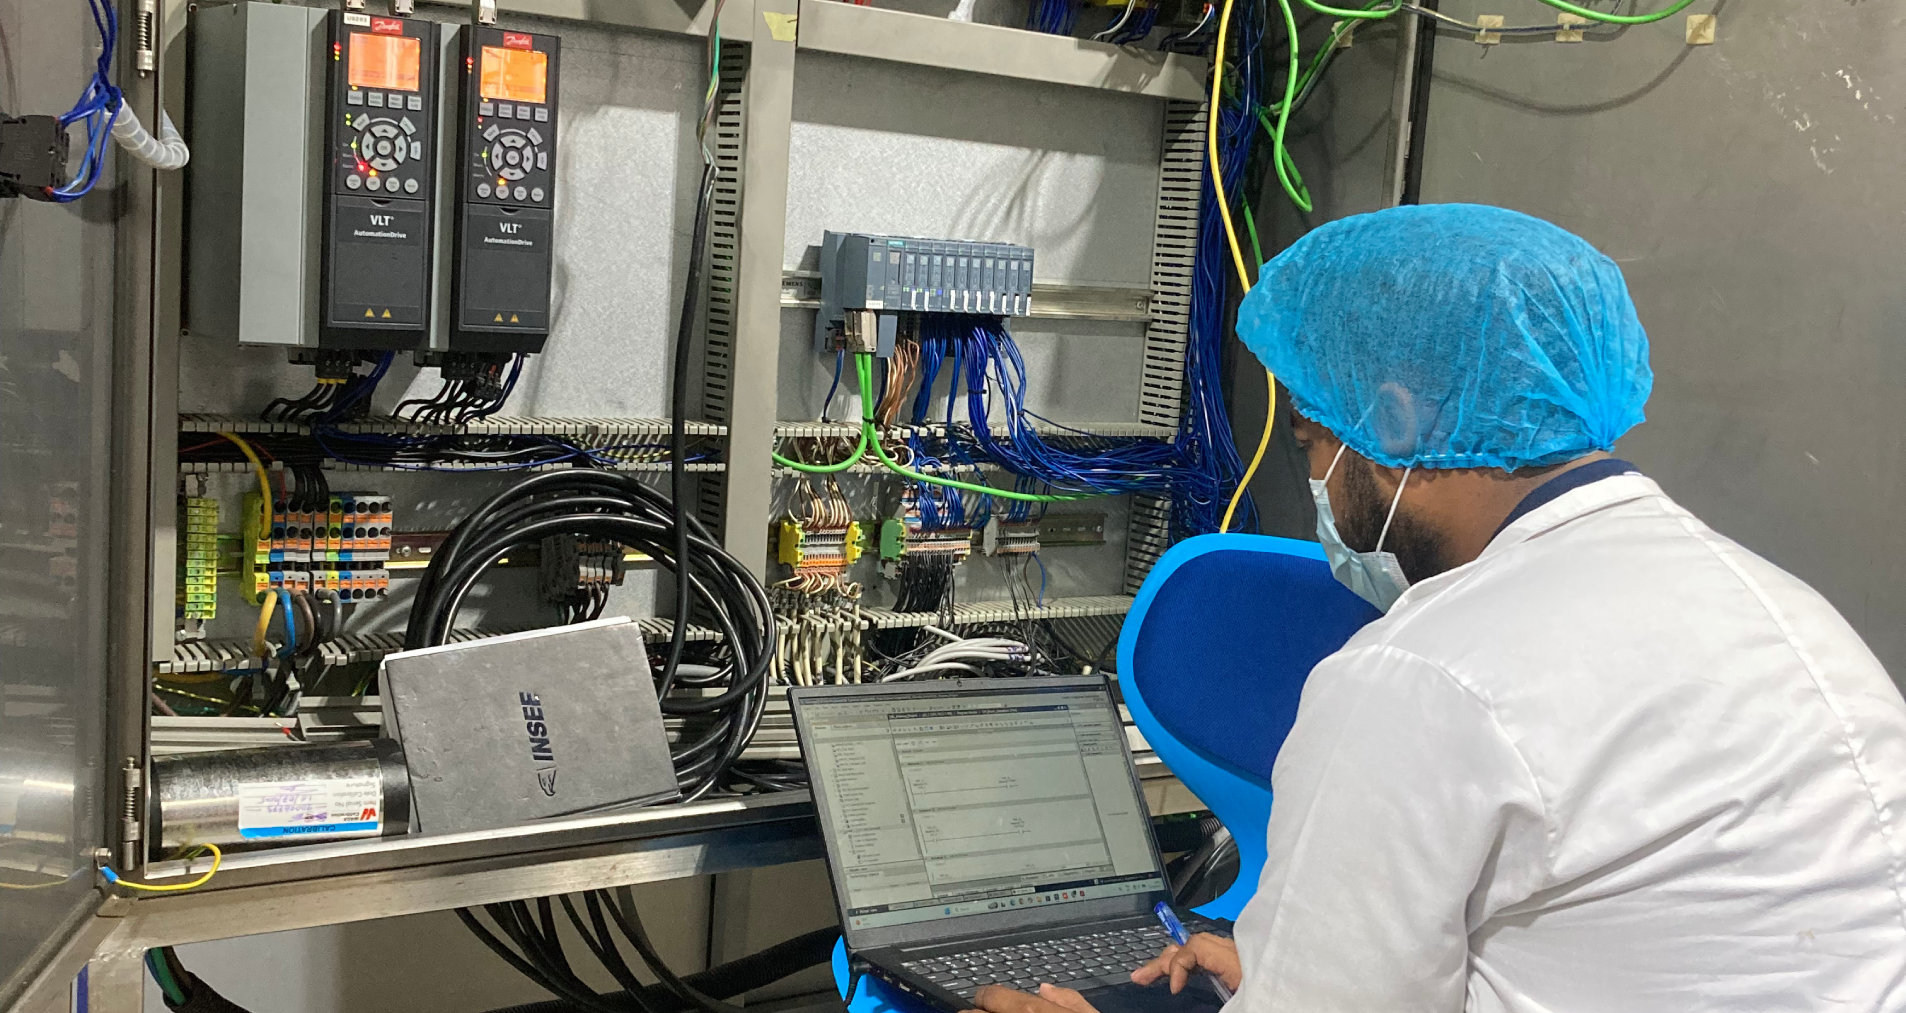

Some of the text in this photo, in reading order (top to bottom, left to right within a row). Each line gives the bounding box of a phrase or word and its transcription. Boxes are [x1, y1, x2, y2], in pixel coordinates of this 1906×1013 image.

[353, 229, 407, 239] AutomationDrive
[483, 236, 533, 247] AutomationDrive
[332, 791, 363, 799] Calibration
[282, 825, 336, 834] CALIBRATION
